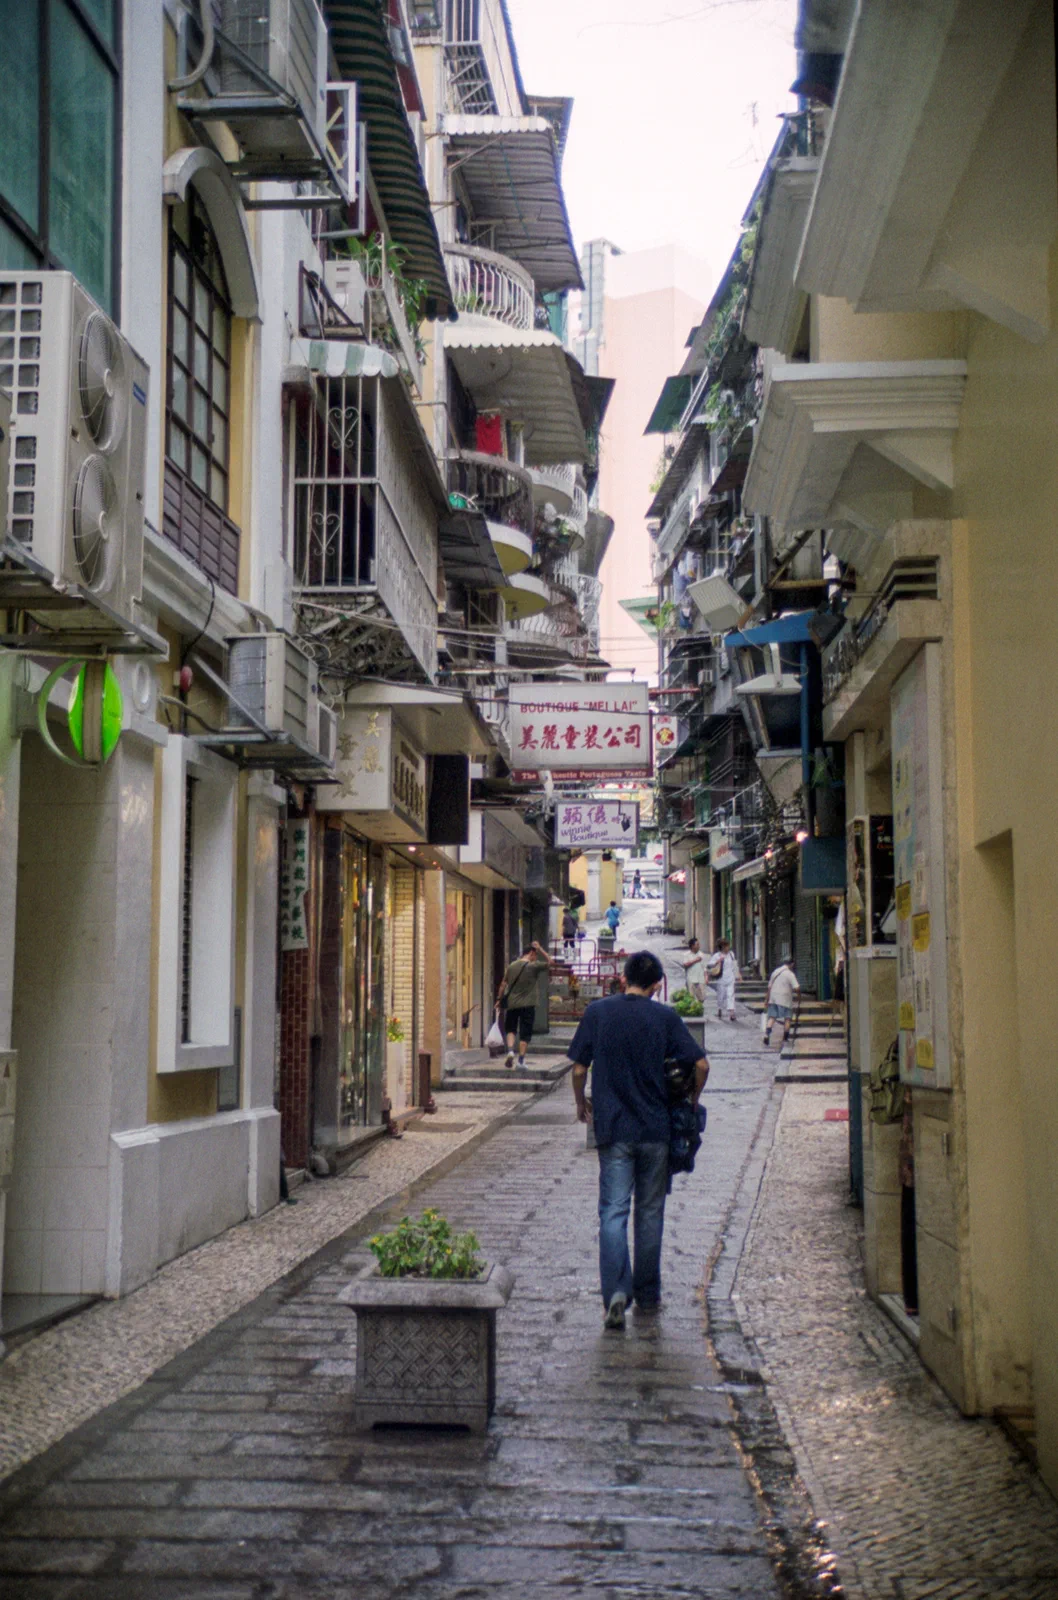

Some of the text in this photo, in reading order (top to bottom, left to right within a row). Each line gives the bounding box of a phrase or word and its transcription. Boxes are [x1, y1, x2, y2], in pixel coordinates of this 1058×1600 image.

[520, 702, 579, 713] BOUTIQUE
[518, 724, 641, 750] 美麗童裝公司
[521, 772, 537, 780] The
[580, 770, 622, 780] Portuguese
[569, 830, 608, 843] Boutique
